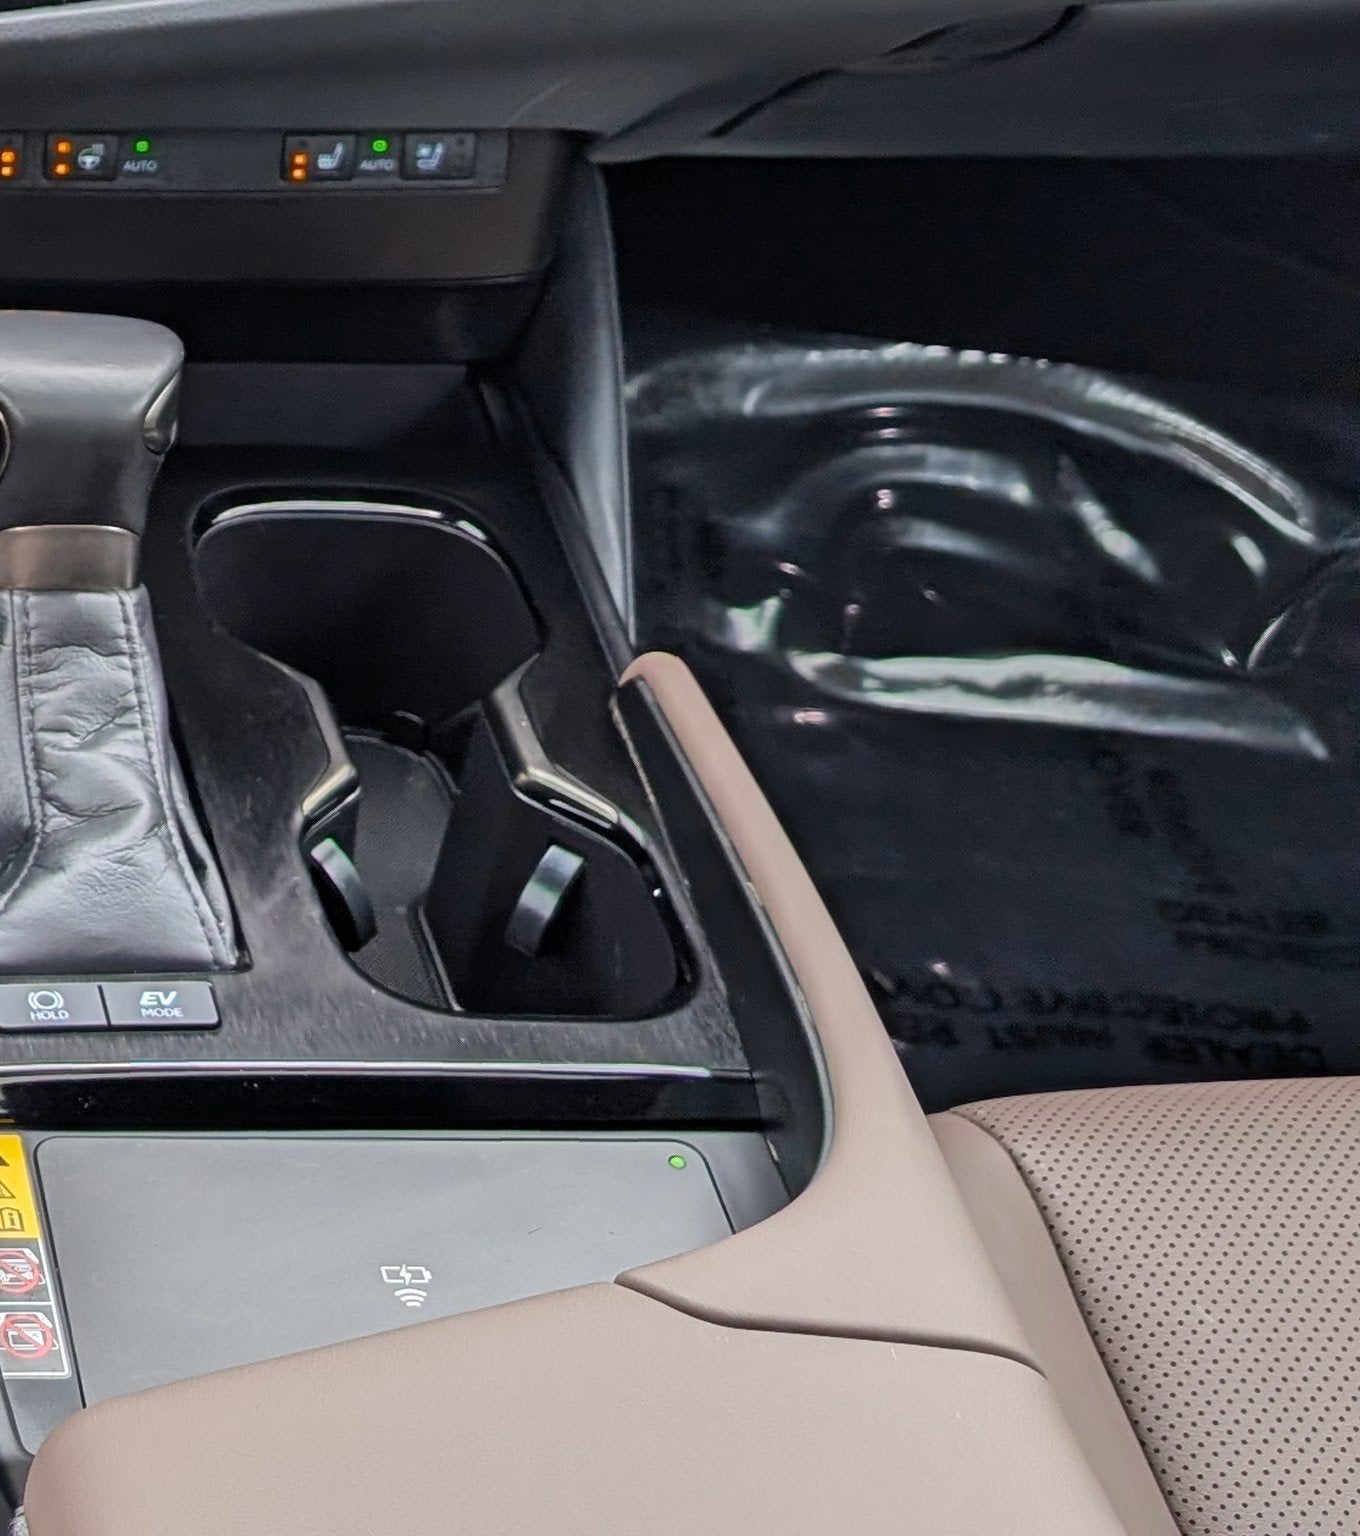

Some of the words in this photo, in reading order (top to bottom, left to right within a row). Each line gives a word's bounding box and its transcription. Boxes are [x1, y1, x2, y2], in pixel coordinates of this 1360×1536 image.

[122, 159, 159, 172] AUTO
[359, 158, 396, 172] AUTO
[139, 990, 178, 1005] EV
[30, 1010, 70, 1021] HOLD
[141, 1007, 184, 1018] MODE
